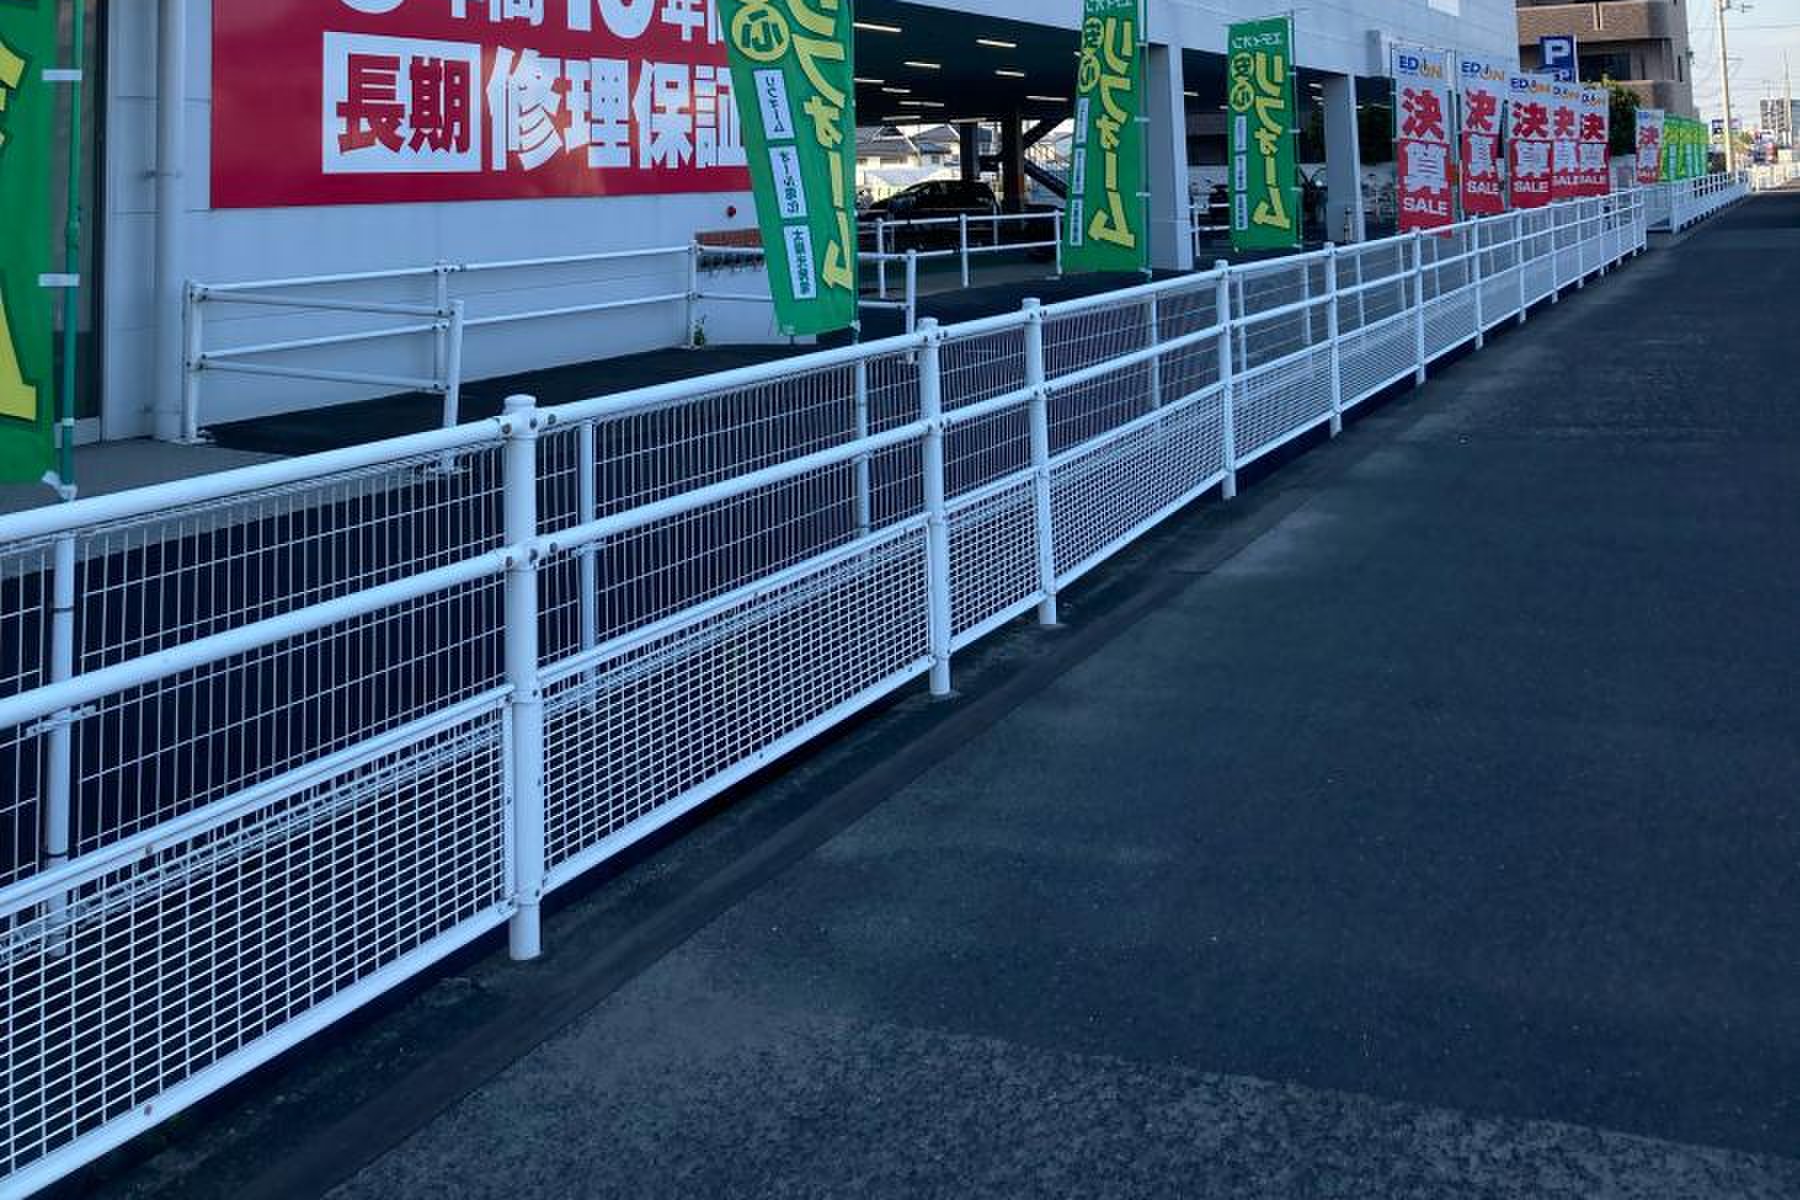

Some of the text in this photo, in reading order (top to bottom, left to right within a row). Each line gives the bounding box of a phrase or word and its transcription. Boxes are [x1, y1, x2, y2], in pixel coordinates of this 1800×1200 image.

[1544, 38, 1570, 65] P
[1467, 180, 1500, 195] SALE
[1513, 181, 1549, 193] SALE
[1403, 197, 1448, 216] SALE
